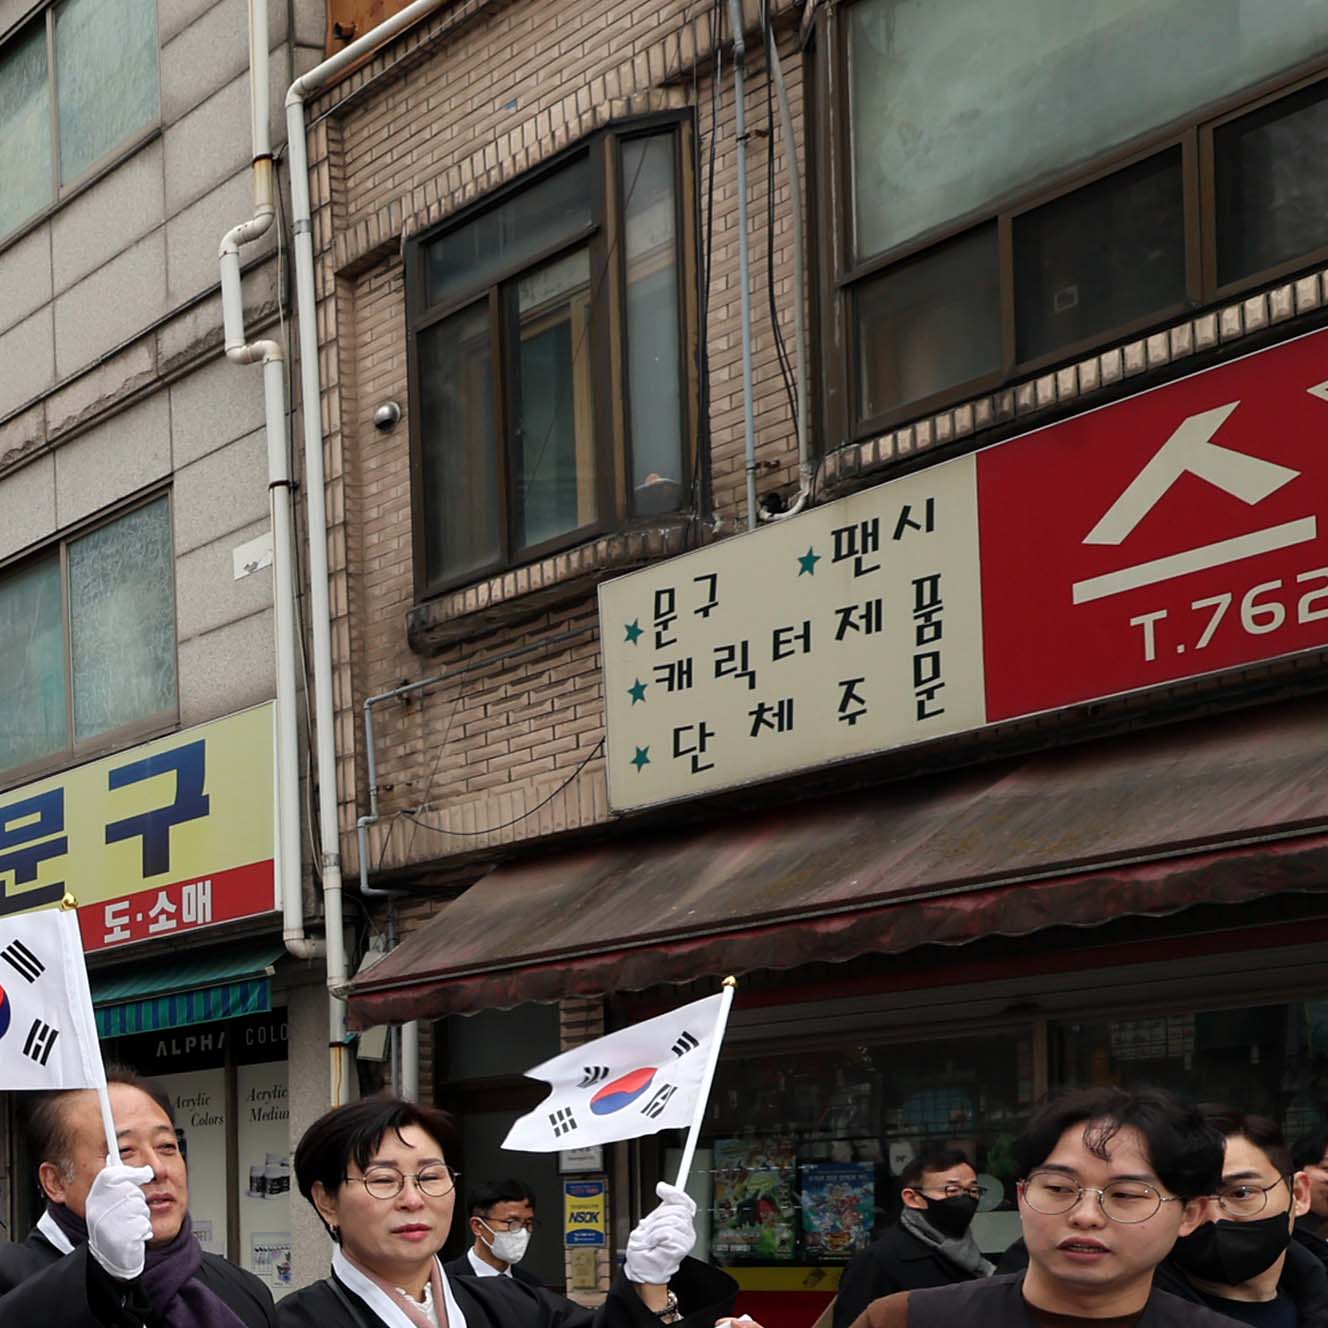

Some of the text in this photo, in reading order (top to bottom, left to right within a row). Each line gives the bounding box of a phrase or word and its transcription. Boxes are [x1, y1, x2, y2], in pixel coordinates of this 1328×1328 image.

[1073, 379, 1328, 606] 스
[654, 497, 935, 649] 문구 팬시
[1130, 566, 1328, 662] T.762
[191, 1111, 224, 1128] Colors
